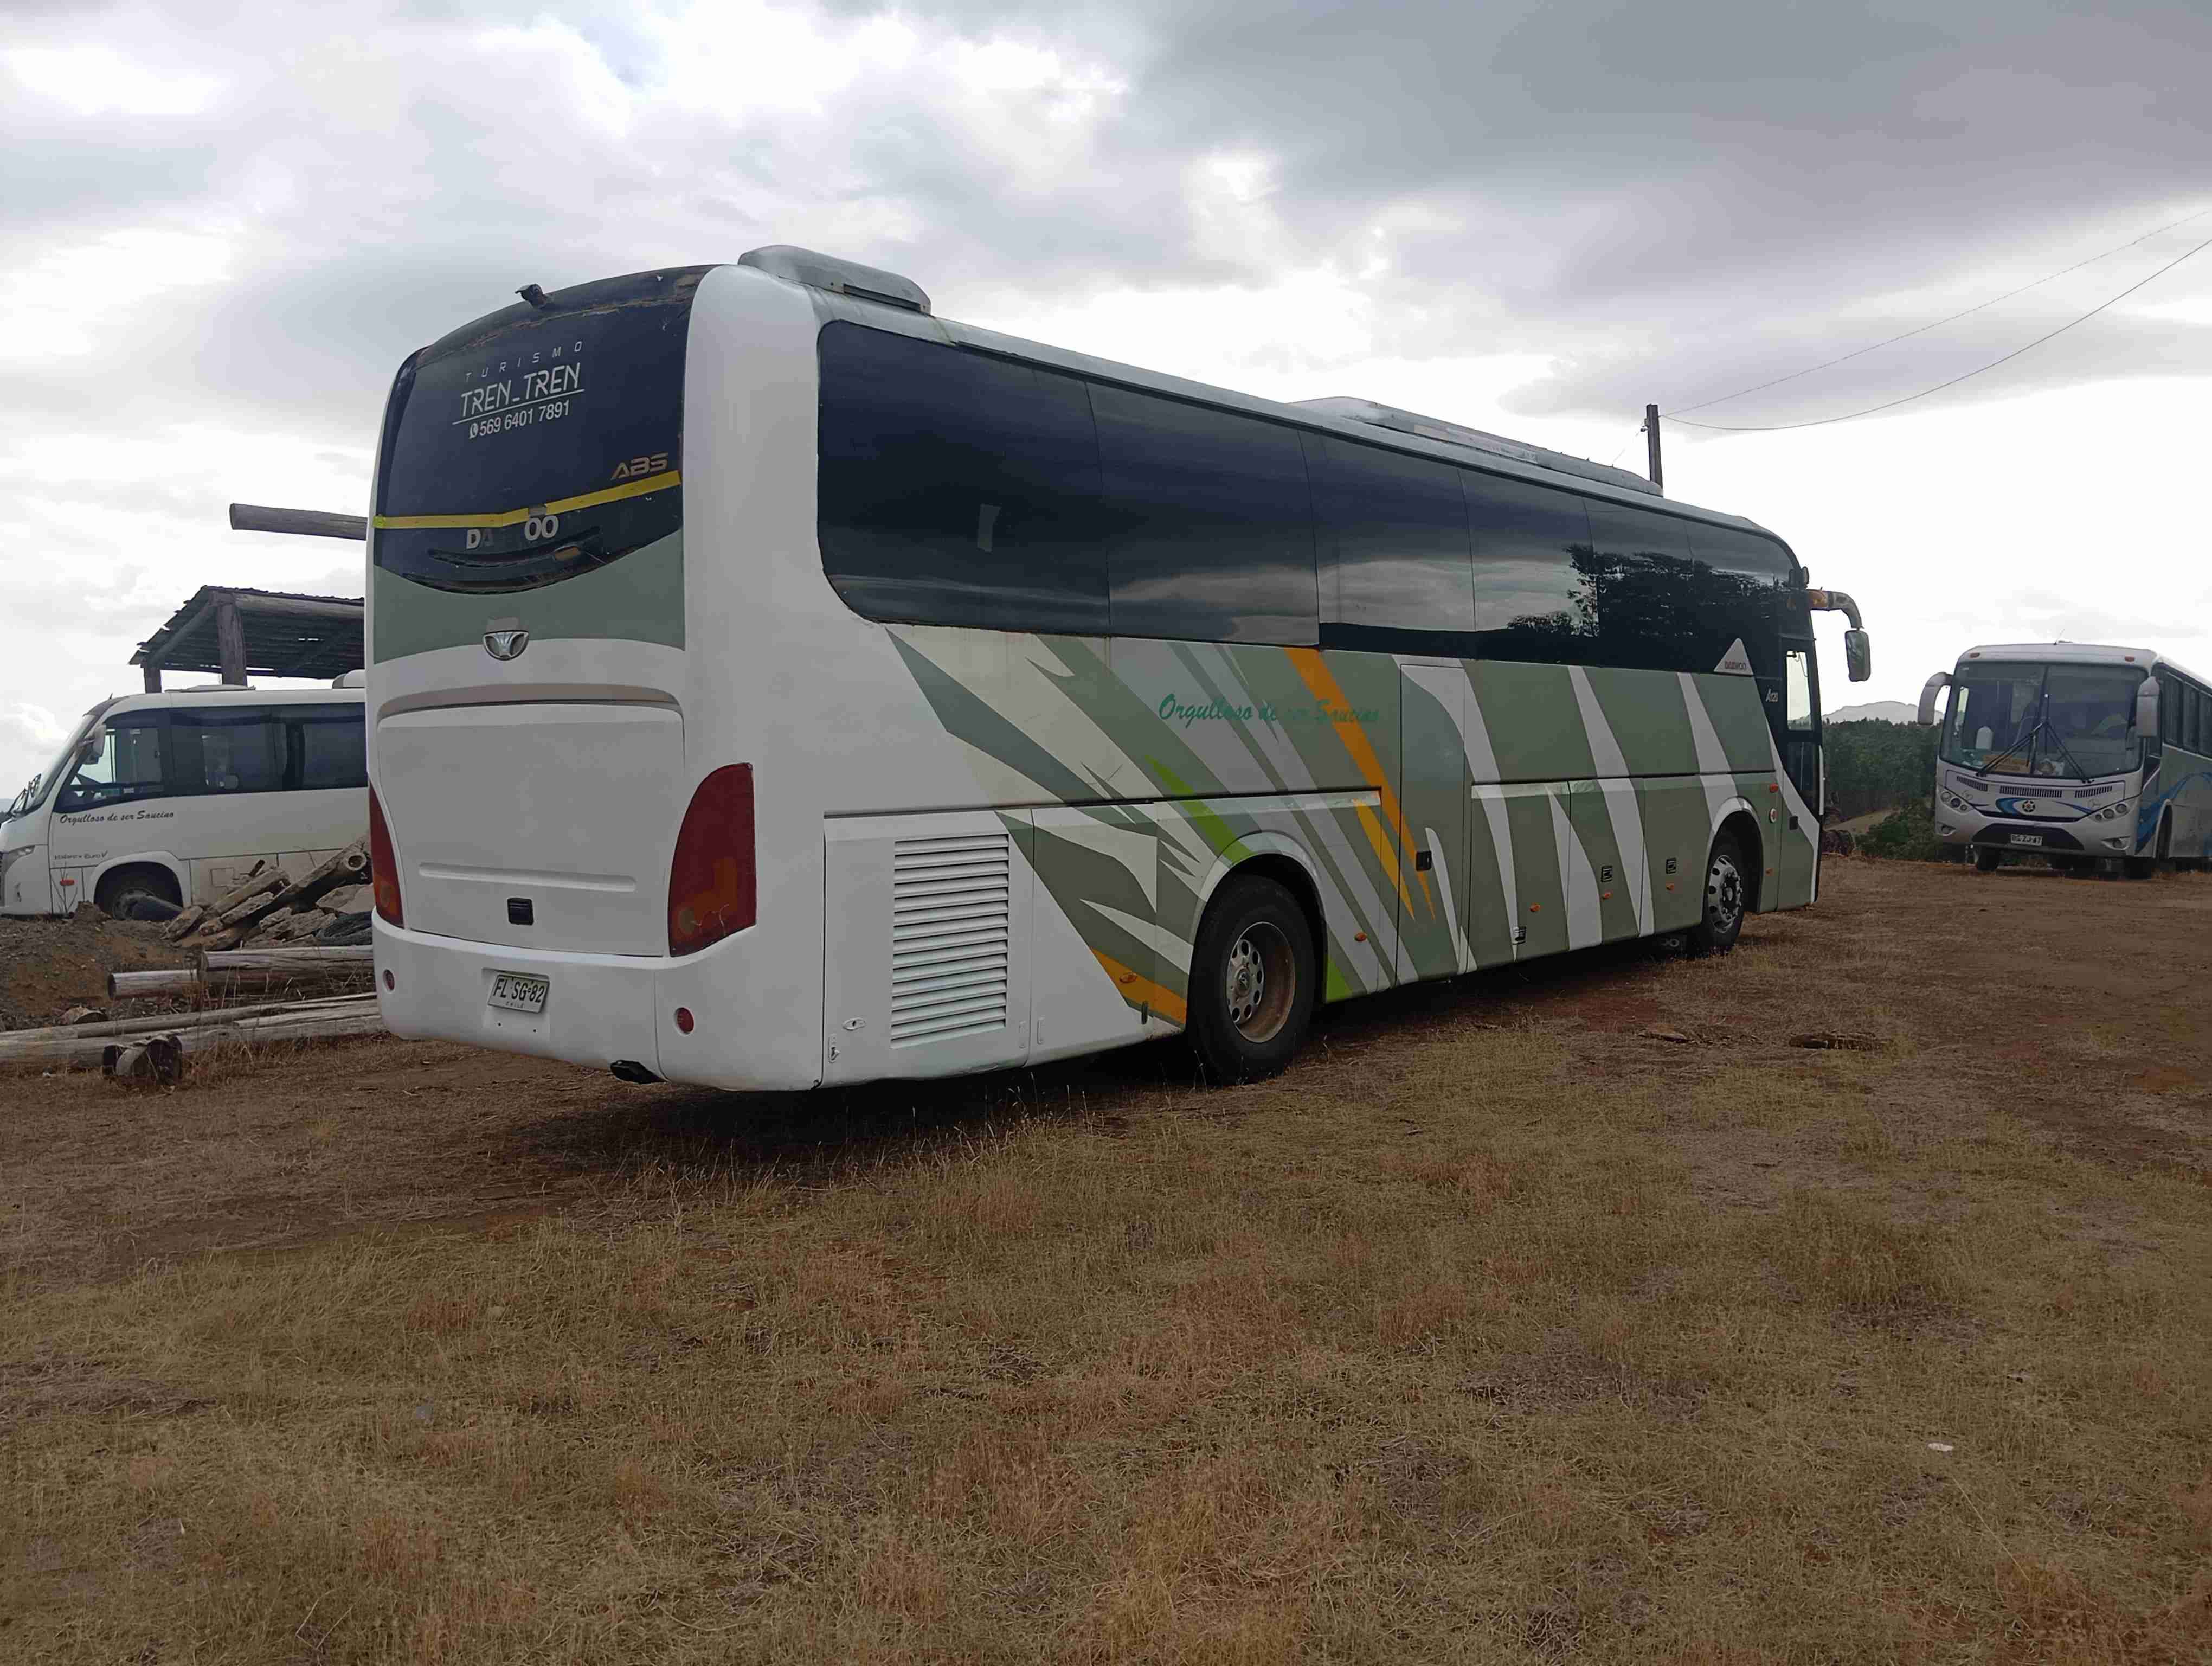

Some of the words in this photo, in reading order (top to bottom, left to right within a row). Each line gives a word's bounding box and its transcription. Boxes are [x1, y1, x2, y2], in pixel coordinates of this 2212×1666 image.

[465, 341, 583, 382] TURISMO
[504, 408, 533, 430] 6401
[538, 400, 569, 421] 7891
[610, 452, 668, 481] ABS
[1158, 694, 1253, 728] Orgulloso
[60, 814, 105, 826] Orgulloso
[107, 813, 118, 821] de
[136, 810, 175, 820] Saucino
